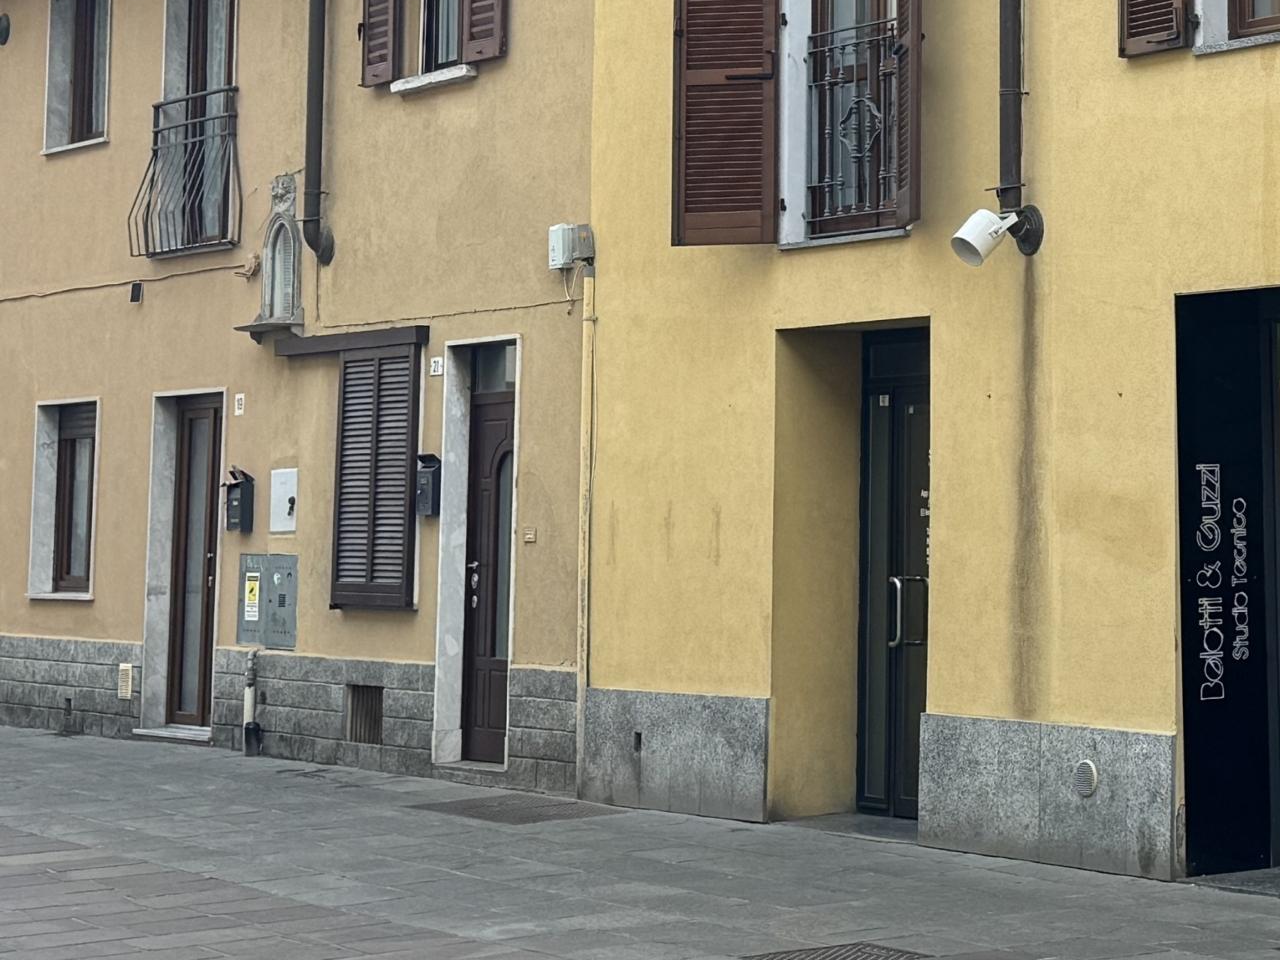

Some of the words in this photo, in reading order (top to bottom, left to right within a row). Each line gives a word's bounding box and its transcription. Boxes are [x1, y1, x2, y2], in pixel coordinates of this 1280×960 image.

[1195, 463, 1222, 551] Guzzi
[1230, 497, 1247, 587] Tecnico
[1196, 560, 1222, 589] &
[1198, 597, 1225, 701] Belotti
[1231, 591, 1249, 661] Studio
